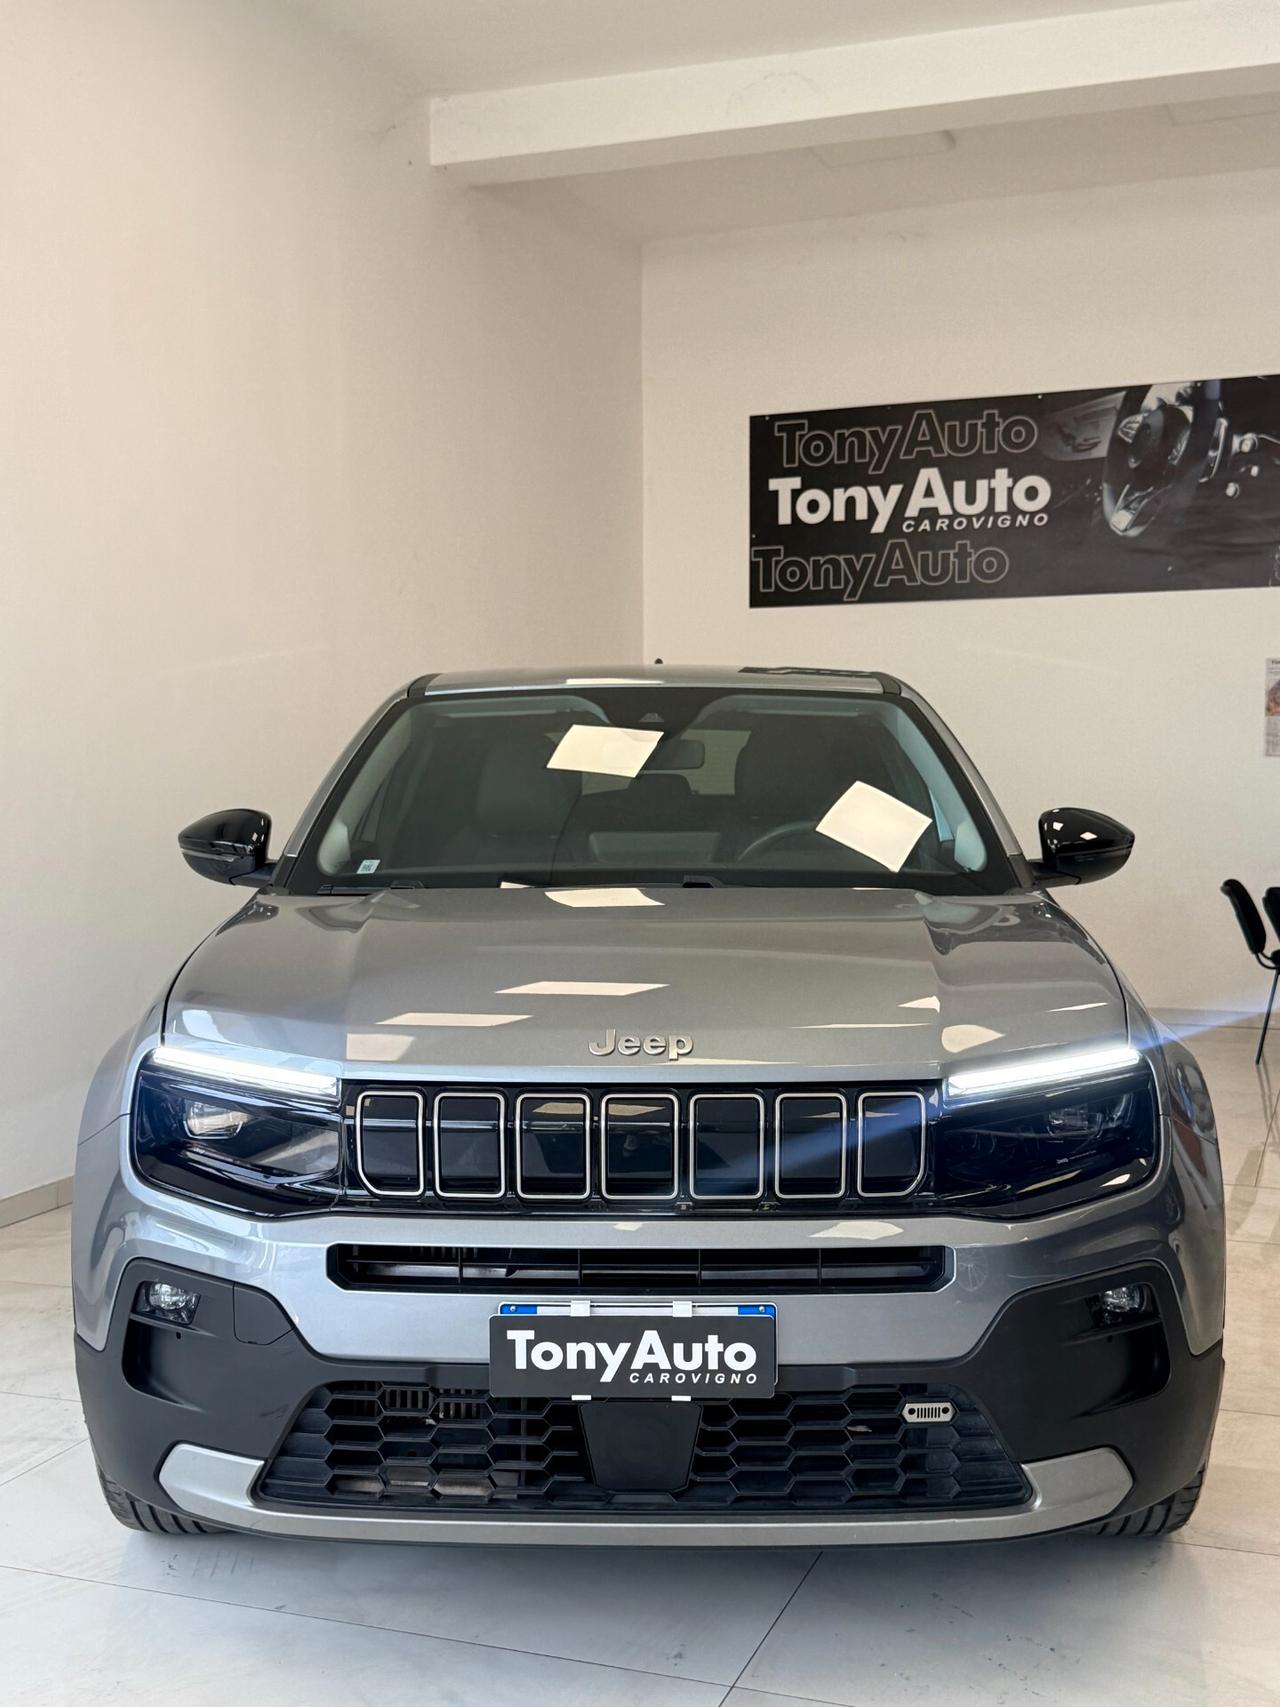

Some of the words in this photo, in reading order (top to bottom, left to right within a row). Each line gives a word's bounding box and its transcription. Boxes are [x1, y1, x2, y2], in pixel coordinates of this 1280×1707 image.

[775, 410, 1038, 474] TonyAuto
[768, 467, 1052, 534] TonyAuto
[902, 513, 1049, 532] CAROVIGNO
[752, 540, 1009, 601] TonyAuto
[588, 1028, 694, 1060] Jeep
[506, 1330, 757, 1383] TonyAuto
[629, 1372, 757, 1384] CAROVIGNO
